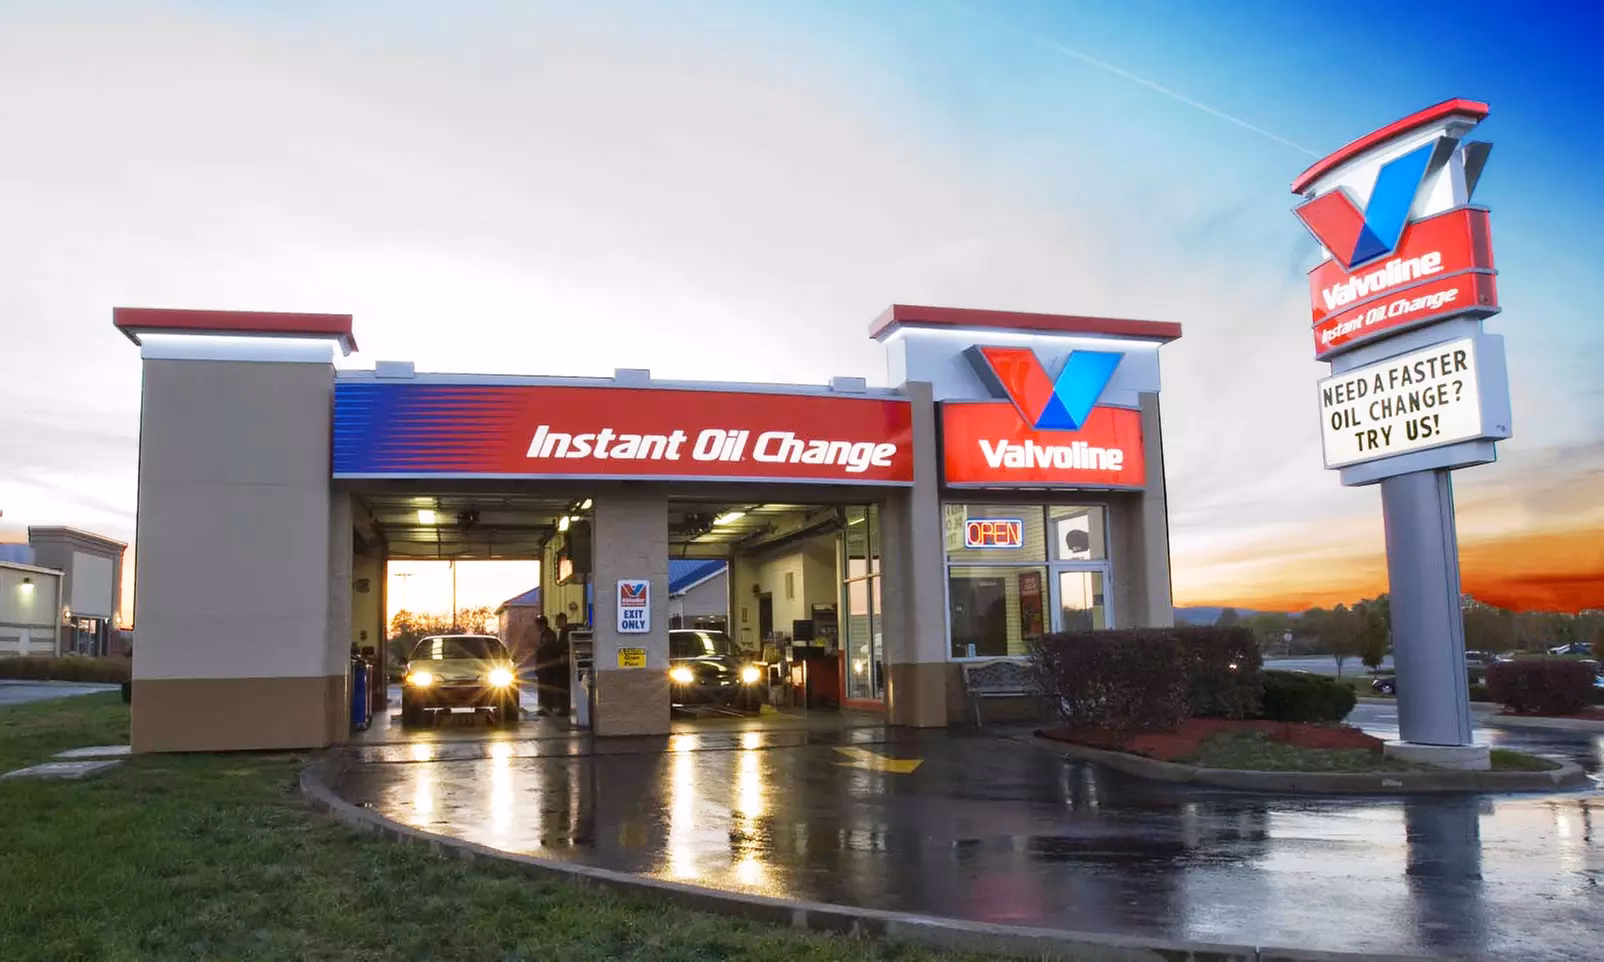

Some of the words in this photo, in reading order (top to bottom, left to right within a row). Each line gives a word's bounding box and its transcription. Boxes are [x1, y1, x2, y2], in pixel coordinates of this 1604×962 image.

[1322, 251, 1444, 310] Valvoline
[1321, 314, 1364, 344] Instant
[1365, 305, 1387, 325] Oil
[1388, 288, 1458, 318] Change
[1323, 378, 1368, 407] NEED
[1373, 373, 1384, 394] A
[1389, 349, 1468, 390] FASTER
[1331, 407, 1361, 431] OIL
[1369, 380, 1463, 421] CHANGE?
[526, 425, 687, 460] Instant
[693, 429, 747, 462] Oil
[752, 431, 897, 472] Change
[1355, 425, 1392, 451] TRY
[1406, 414, 1440, 441] US!
[978, 439, 1124, 471] Valvoline
[968, 522, 1020, 545] OPEN
[621, 620, 645, 629] ONLY
[624, 610, 643, 619] EXIT
